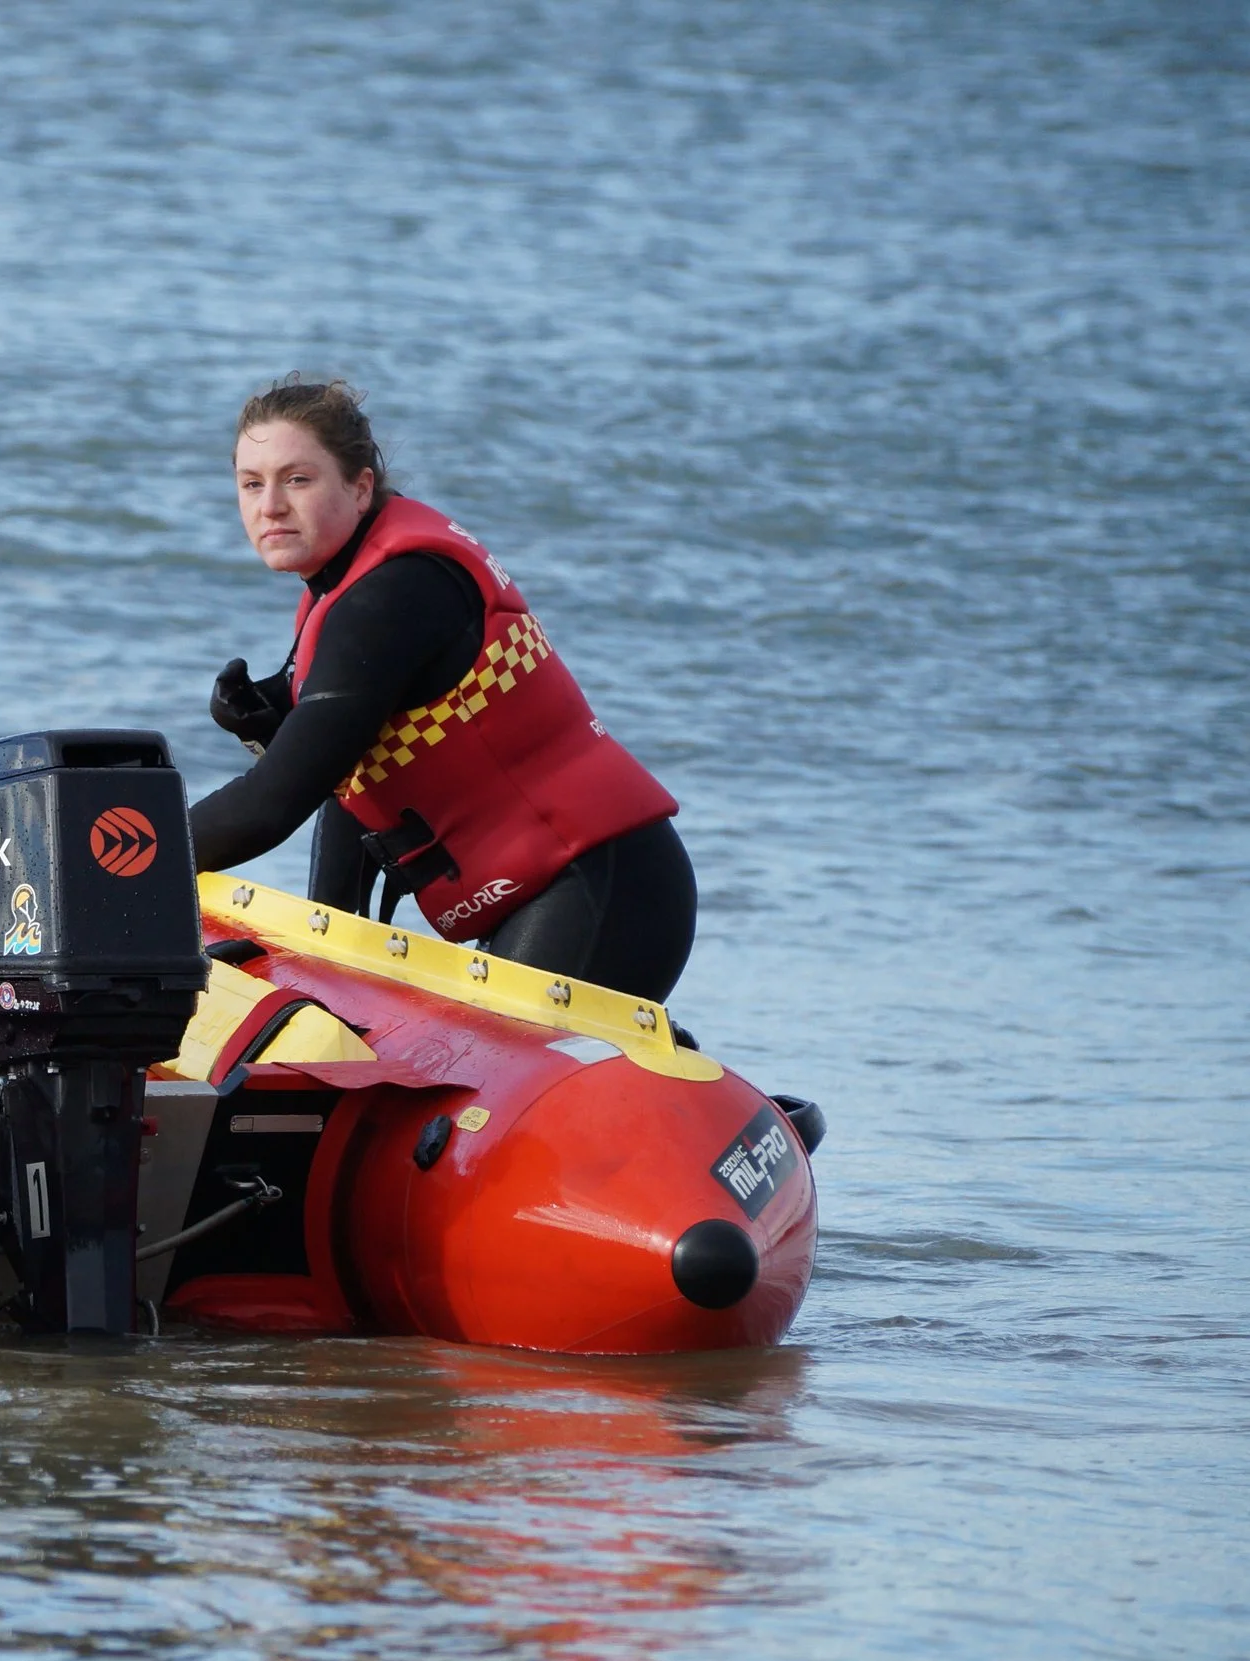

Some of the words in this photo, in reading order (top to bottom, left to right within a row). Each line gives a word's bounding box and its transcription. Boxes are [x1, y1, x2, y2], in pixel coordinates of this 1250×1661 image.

[718, 1144, 748, 1178] ZODIAC
[729, 1124, 788, 1200] MILPRO
[32, 1167, 45, 1232] 1
